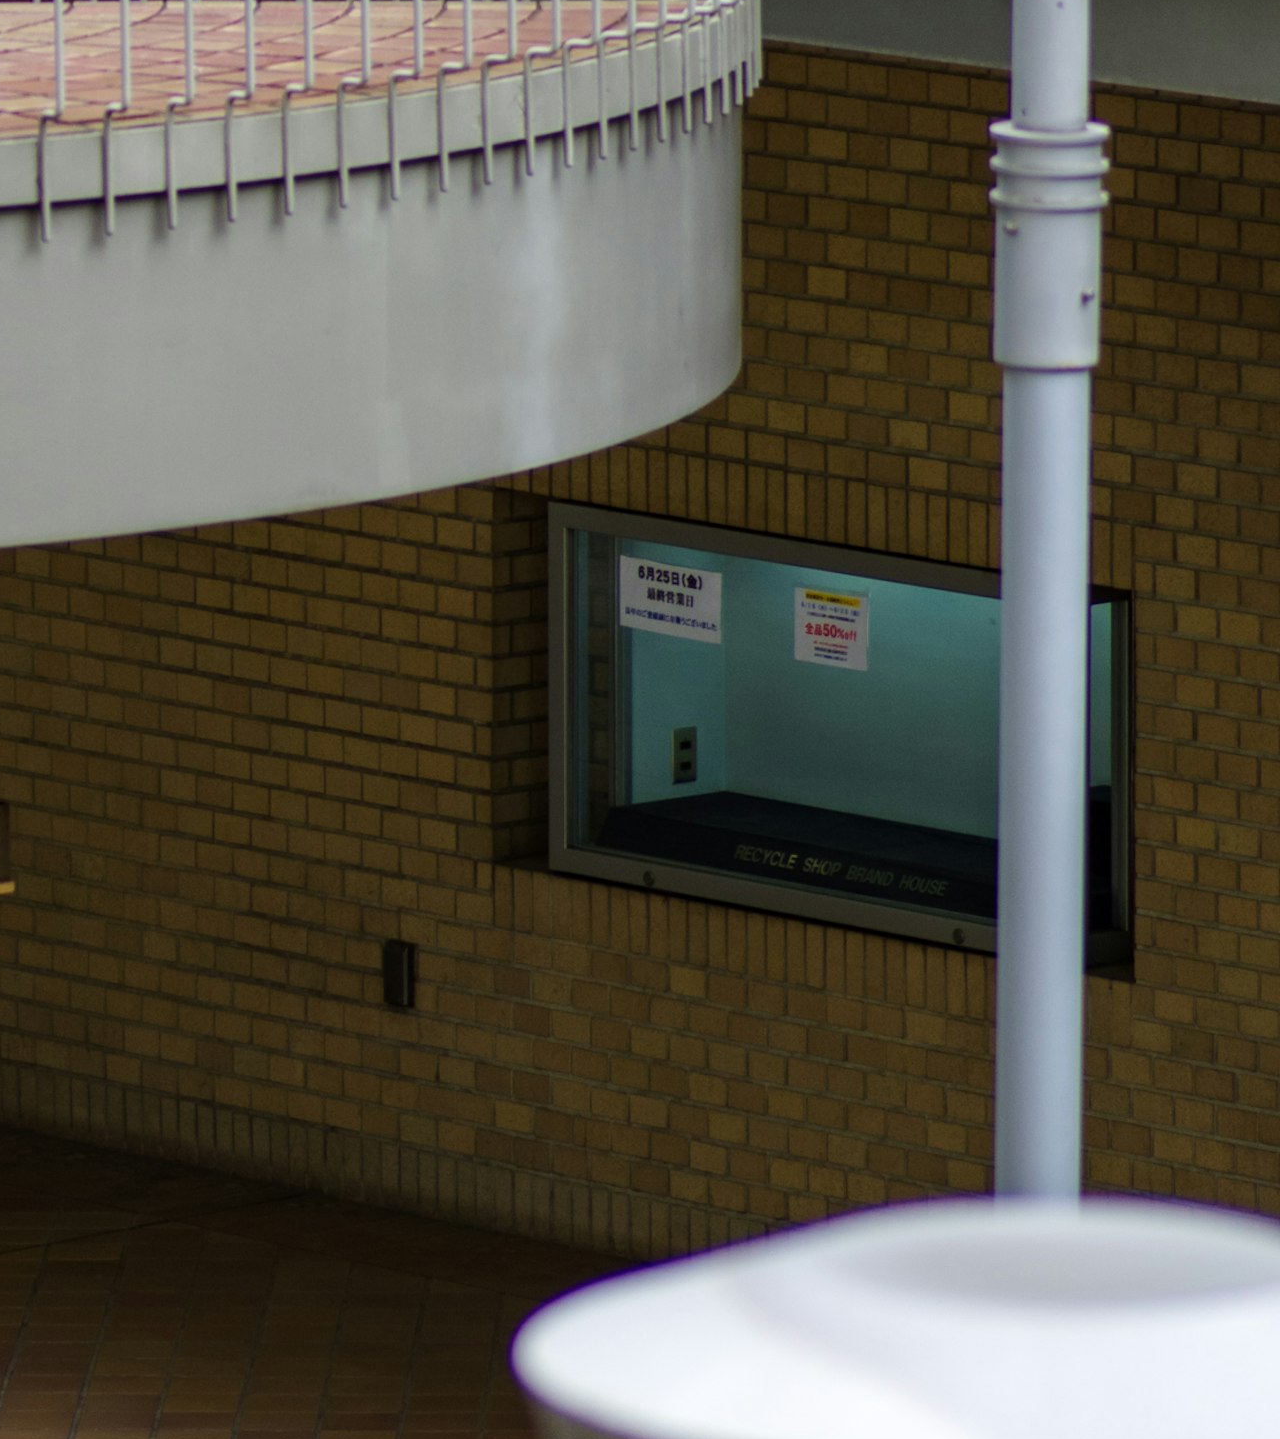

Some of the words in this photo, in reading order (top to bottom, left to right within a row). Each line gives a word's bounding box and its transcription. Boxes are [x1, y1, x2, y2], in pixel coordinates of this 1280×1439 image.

[637, 564, 703, 590] 6月25日(金)
[646, 587, 694, 608] 最終営業日
[804, 621, 857, 641] 全品50%off
[734, 843, 798, 870] RECYCLE
[802, 856, 842, 878] SHOP
[845, 864, 895, 887] BRAND
[898, 873, 949, 897] HOUSE
